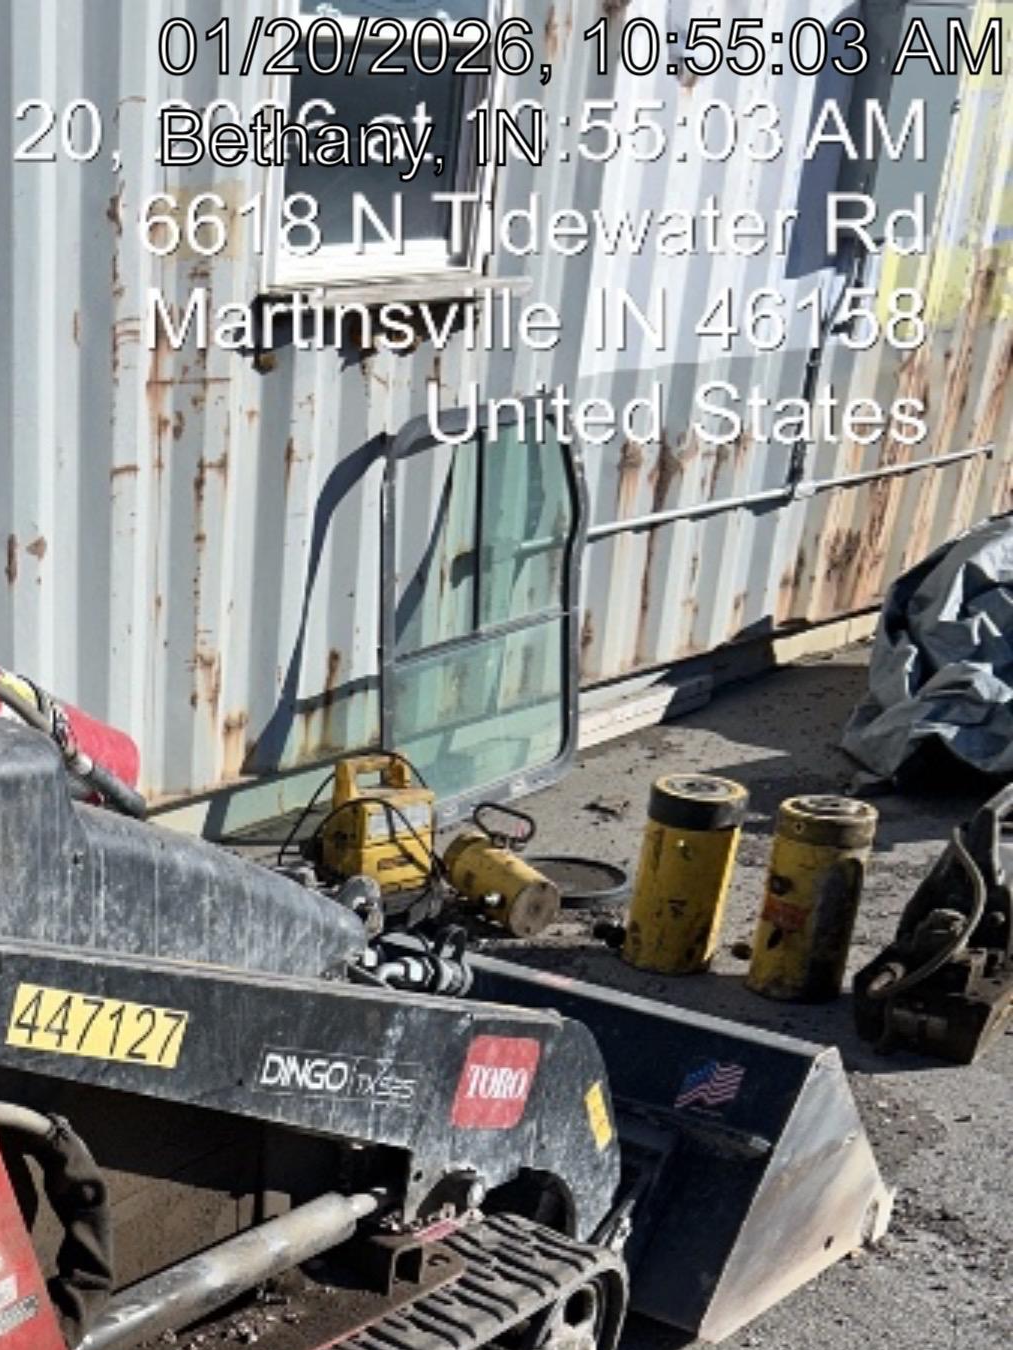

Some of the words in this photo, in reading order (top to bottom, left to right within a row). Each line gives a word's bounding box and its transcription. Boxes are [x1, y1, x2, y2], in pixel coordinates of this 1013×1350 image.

[14, 989, 186, 1063] 447127
[259, 1052, 349, 1093] DINGO
[466, 1063, 529, 1100] TORO
